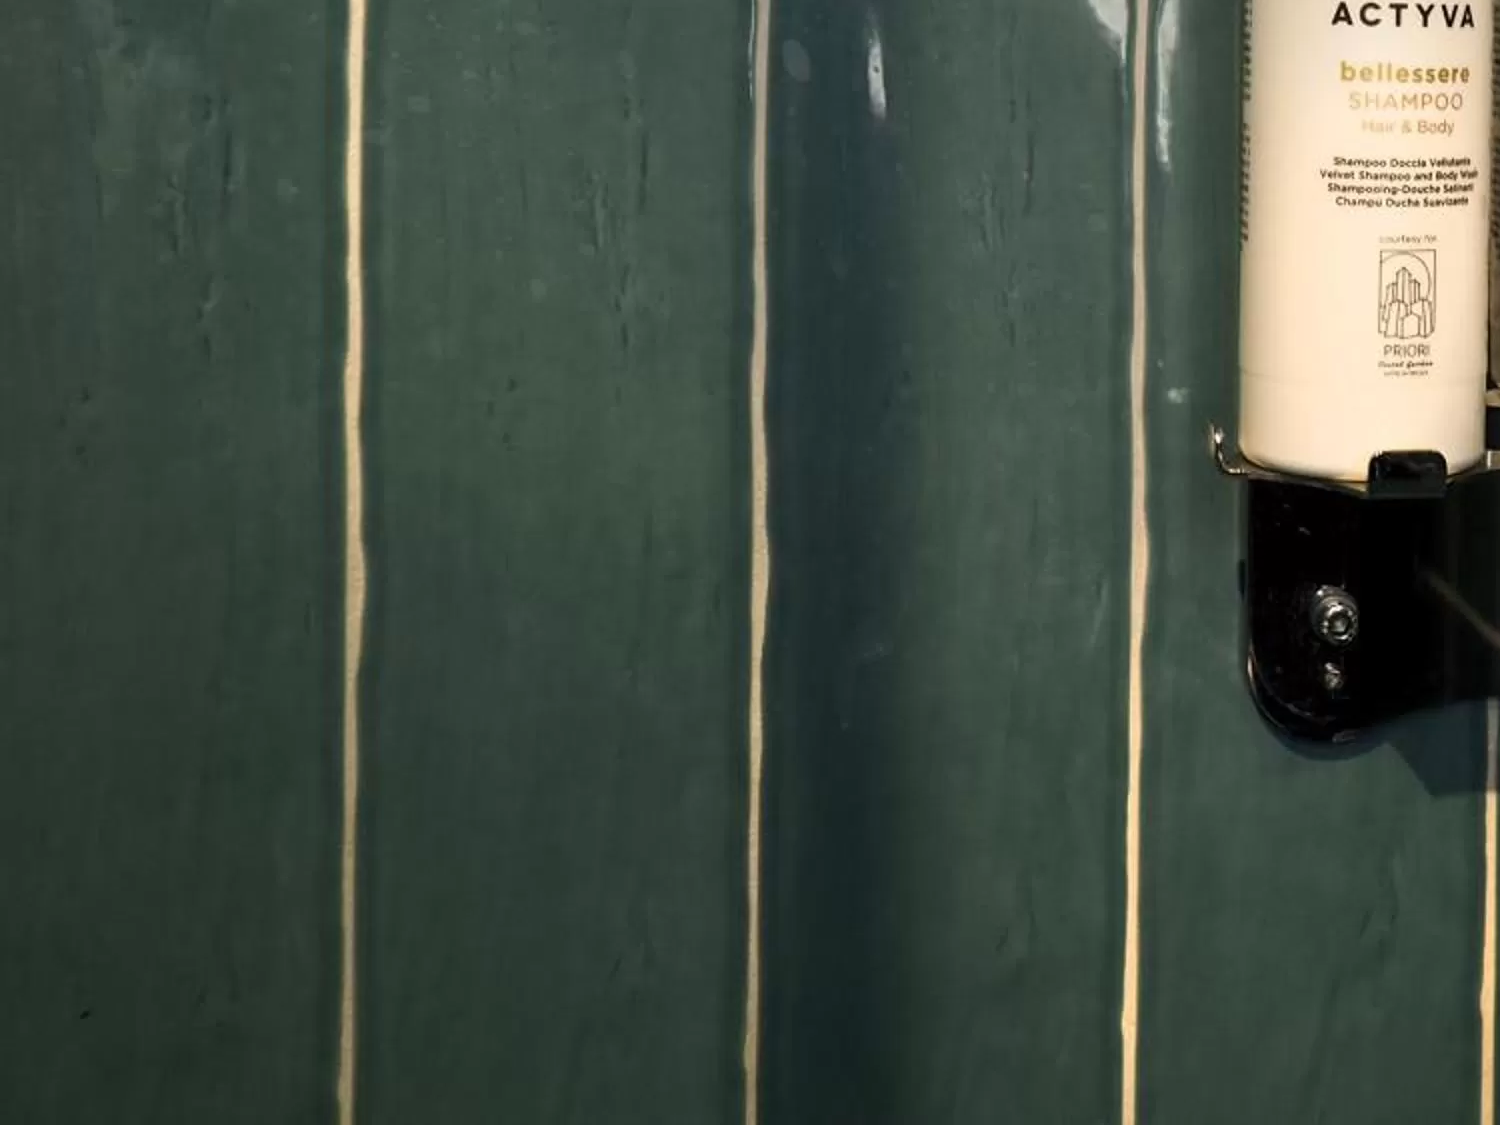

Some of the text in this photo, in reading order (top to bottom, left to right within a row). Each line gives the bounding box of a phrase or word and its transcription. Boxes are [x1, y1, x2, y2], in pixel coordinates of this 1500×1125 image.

[1331, 0, 1475, 28] ACTYVA
[1340, 60, 1470, 84] bellessere
[1348, 91, 1463, 111] SHAMPOO
[1401, 121, 1412, 134] &
[1417, 119, 1455, 137] Body
[1333, 156, 1387, 168] Shampoo
[1319, 169, 1355, 180] Velvet
[1358, 170, 1411, 182] Shampoo
[1413, 171, 1433, 181] and
[1384, 344, 1431, 357] PRIORI
